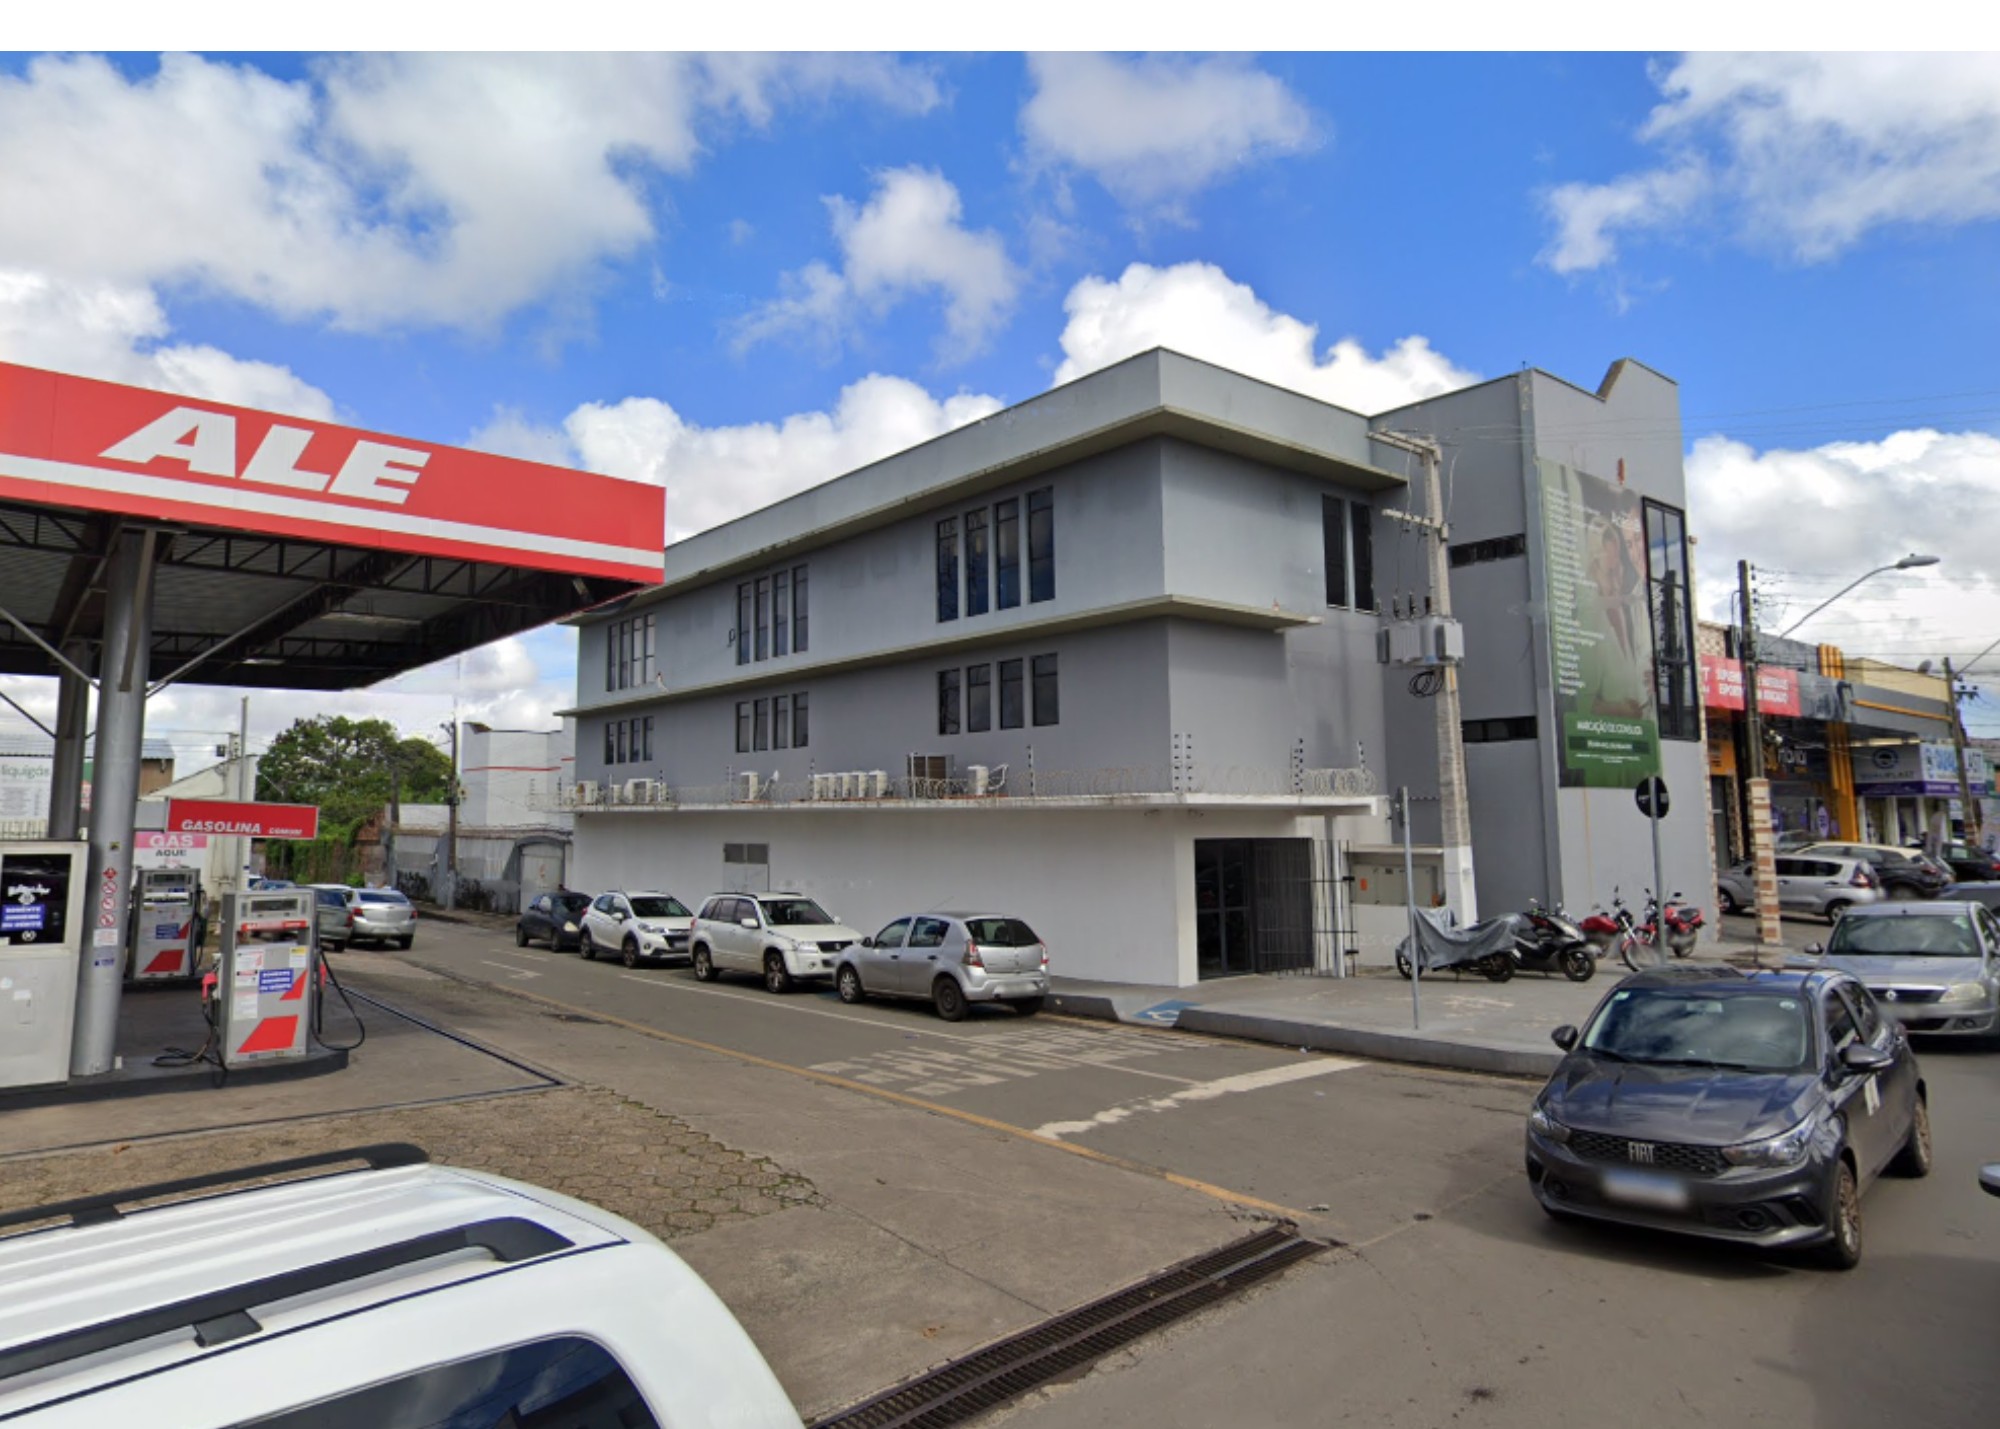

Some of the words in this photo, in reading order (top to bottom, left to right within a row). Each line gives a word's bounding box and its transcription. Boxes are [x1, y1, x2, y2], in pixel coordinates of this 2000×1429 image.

[98, 406, 432, 505] ALE
[181, 819, 261, 834] GASOLINA
[1628, 1141, 1655, 1164] FIAT
